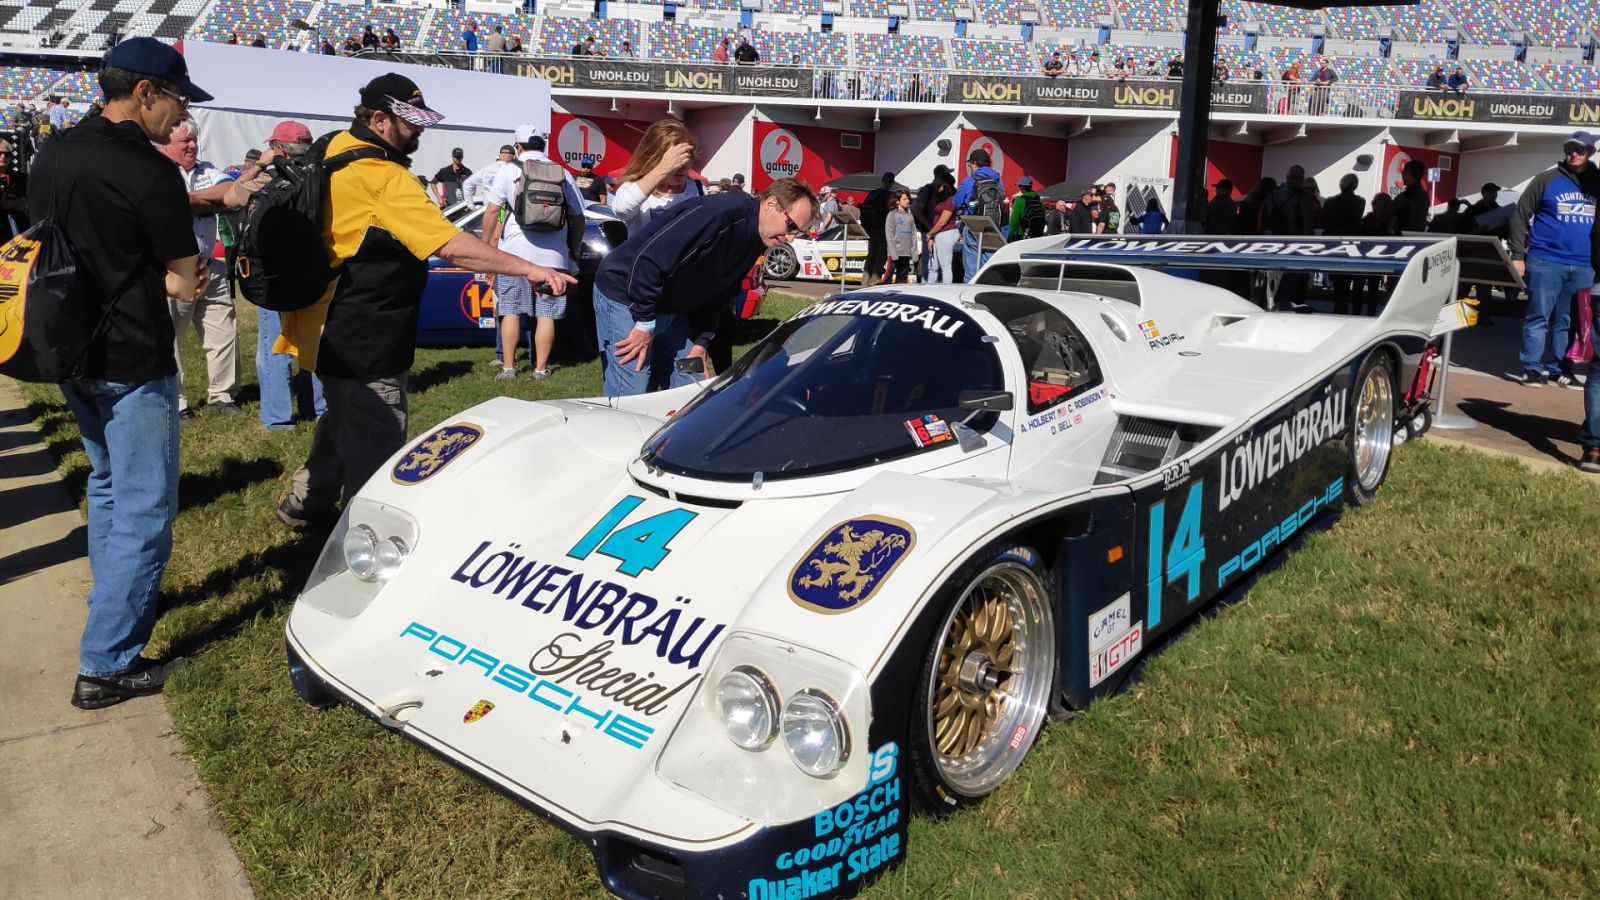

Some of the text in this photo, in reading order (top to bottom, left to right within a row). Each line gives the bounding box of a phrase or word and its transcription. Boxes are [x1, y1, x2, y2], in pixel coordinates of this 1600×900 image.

[589, 70, 650, 82] UNOH.EDU
[664, 68, 723, 89] UNOH
[737, 76, 798, 88] UNOH.EDU
[962, 80, 1021, 100] UNOH
[1037, 87, 1099, 99] UNOH.EDU
[1114, 84, 1174, 105] UNOH
[1210, 93, 1252, 104] H.EDU
[1413, 95, 1475, 117] UNOH
[1490, 103, 1555, 116] UNOH.EDU
[1569, 101, 1600, 121] UN
[578, 125, 588, 155] 1
[775, 135, 791, 164] 2
[765, 162, 800, 175] garage
[1065, 238, 1416, 258] LÖWENBRÄU
[809, 263, 818, 275] 5
[466, 284, 496, 318] 14
[791, 300, 966, 338] LÖWENBRÄU
[1149, 333, 1185, 350] ANDIAL
[1028, 411, 1057, 430] HOLBERT
[1074, 392, 1102, 409] ROBINSON
[1058, 419, 1073, 432] BELL
[1219, 385, 1348, 511] LÖWENBRÄU
[565, 494, 699, 578] 14
[1218, 475, 1344, 589] PORSCHE
[1147, 479, 1206, 630] 14
[450, 540, 727, 670] LÖWENBRÄU
[1093, 608, 1128, 638] CAMEL
[1107, 622, 1116, 634] GT
[1108, 628, 1140, 667] GTP
[400, 621, 655, 750] PORSCHE
[529, 632, 703, 717] Special
[1010, 725, 1026, 749] BBS
[815, 777, 900, 837] BOSCH
[748, 833, 900, 900] Quaker State
